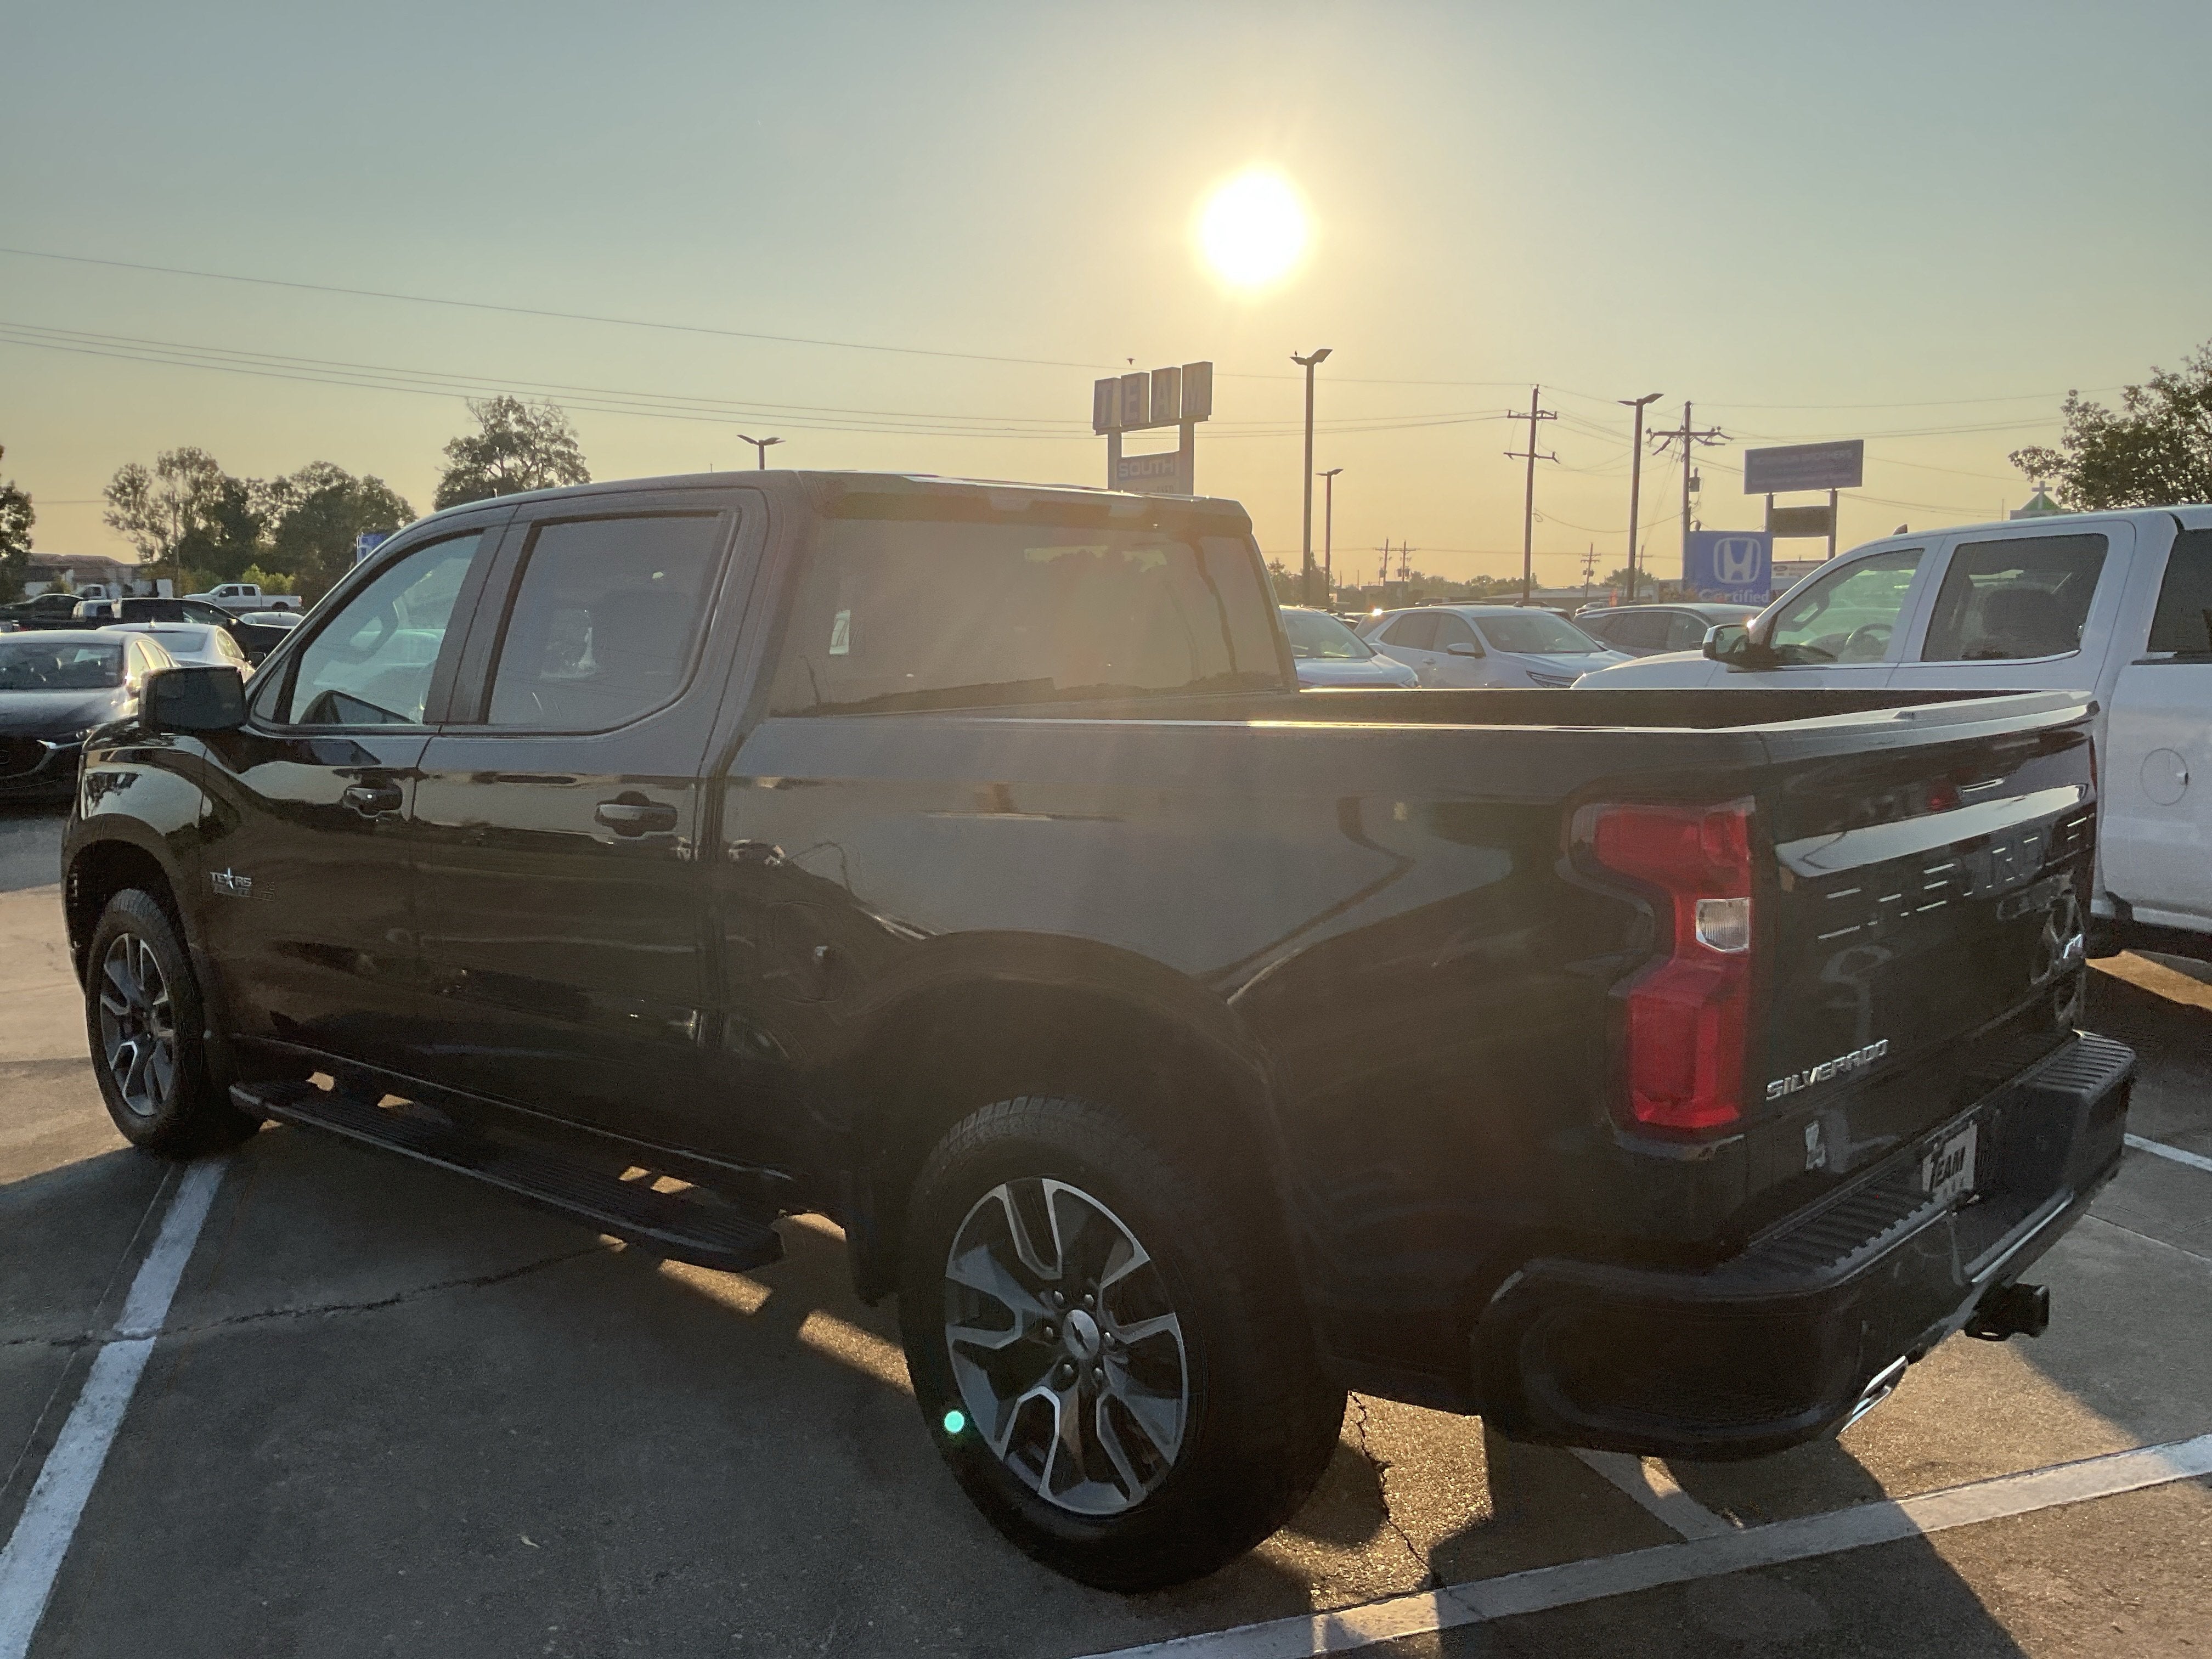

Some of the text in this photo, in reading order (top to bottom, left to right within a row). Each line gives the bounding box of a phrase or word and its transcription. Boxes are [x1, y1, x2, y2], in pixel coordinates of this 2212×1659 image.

[1097, 366, 1209, 427] TEAM
[1118, 458, 1174, 477] SOUTH
[1818, 812, 2095, 940] CEROE
[1766, 1039, 1888, 1101] SILVERADO
